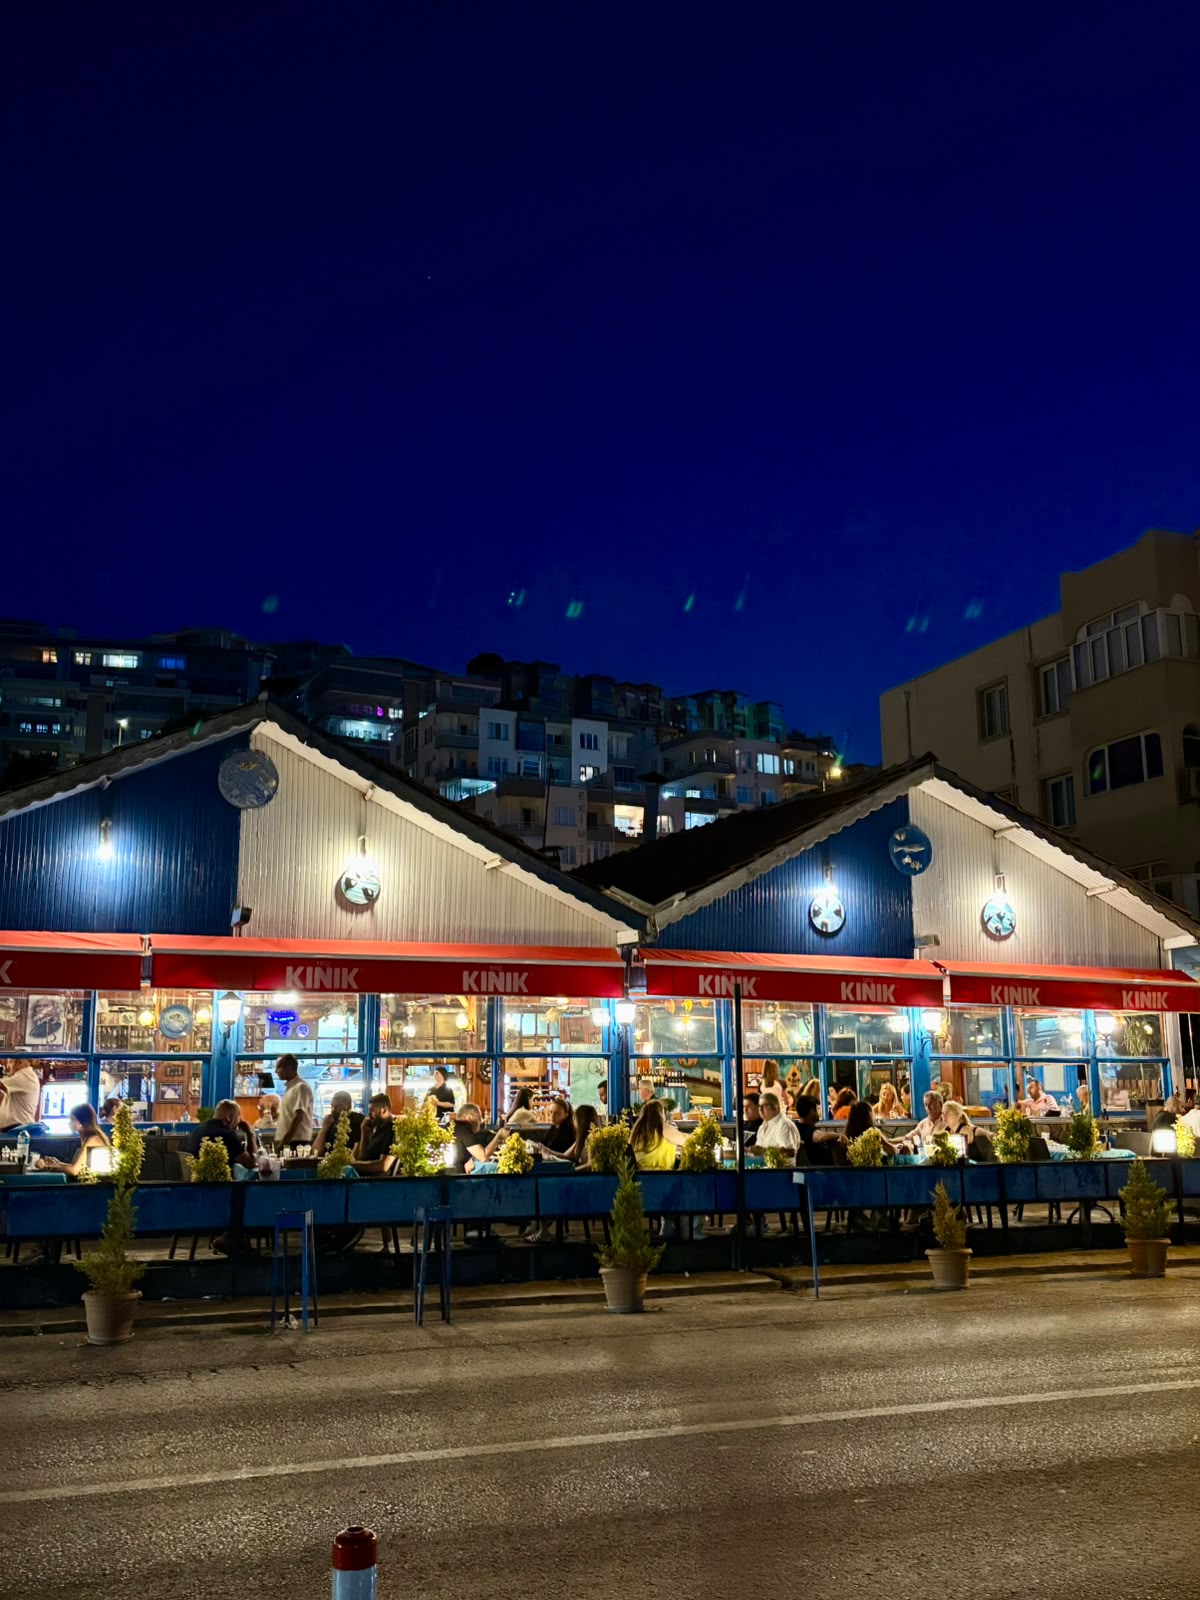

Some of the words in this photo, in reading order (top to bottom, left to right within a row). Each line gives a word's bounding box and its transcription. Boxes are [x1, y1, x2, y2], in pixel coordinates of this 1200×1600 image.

[286, 966, 359, 990] KINIK
[462, 970, 529, 993] KINIK
[698, 975, 757, 996] KINIK
[841, 981, 896, 1003] KINIK
[991, 985, 1040, 1006] KINIK
[1122, 990, 1169, 1009] KINIK
